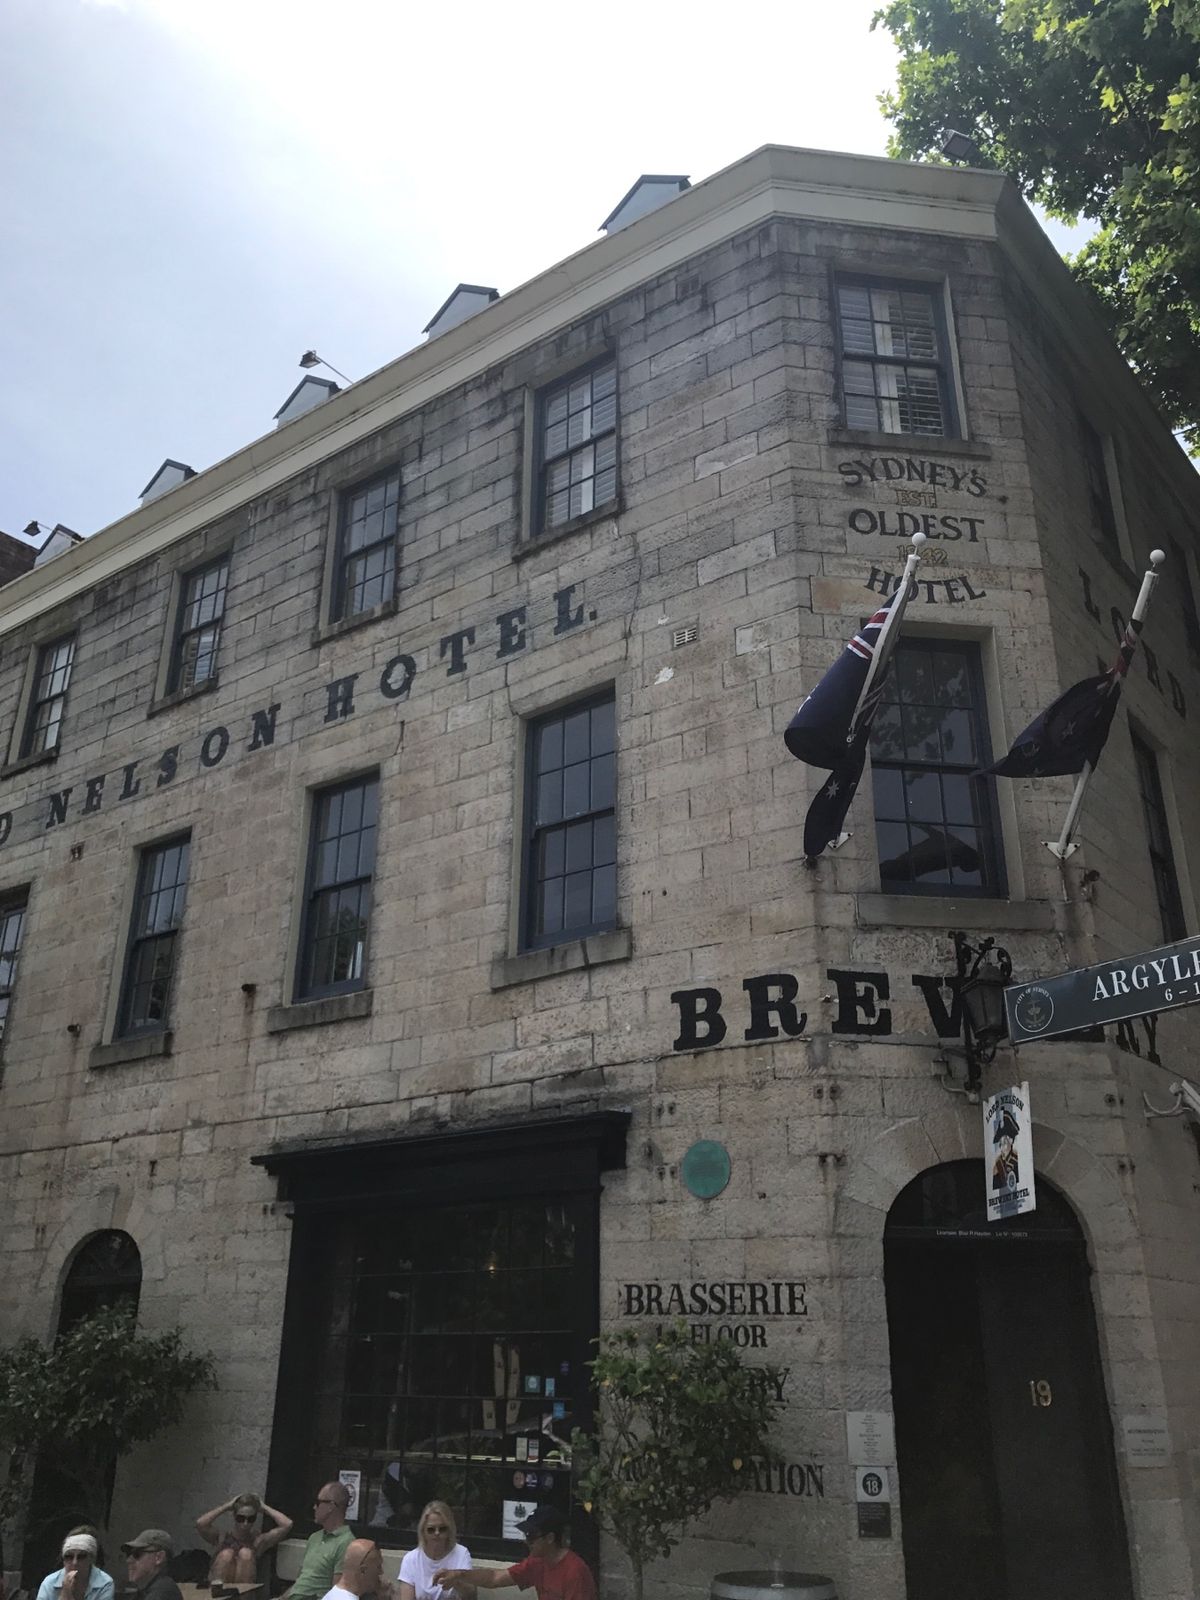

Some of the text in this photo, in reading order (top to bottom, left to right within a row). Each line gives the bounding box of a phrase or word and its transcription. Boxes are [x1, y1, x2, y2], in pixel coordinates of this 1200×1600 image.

[838, 457, 988, 498] SYDNEY'S
[848, 508, 985, 543] OLDEST
[864, 566, 987, 605] HOTEL
[45, 703, 281, 829] NELSON
[623, 1282, 808, 1316] BRASSERIE
[1030, 1380, 1052, 1407] 19
[865, 1480, 879, 1494] 18
